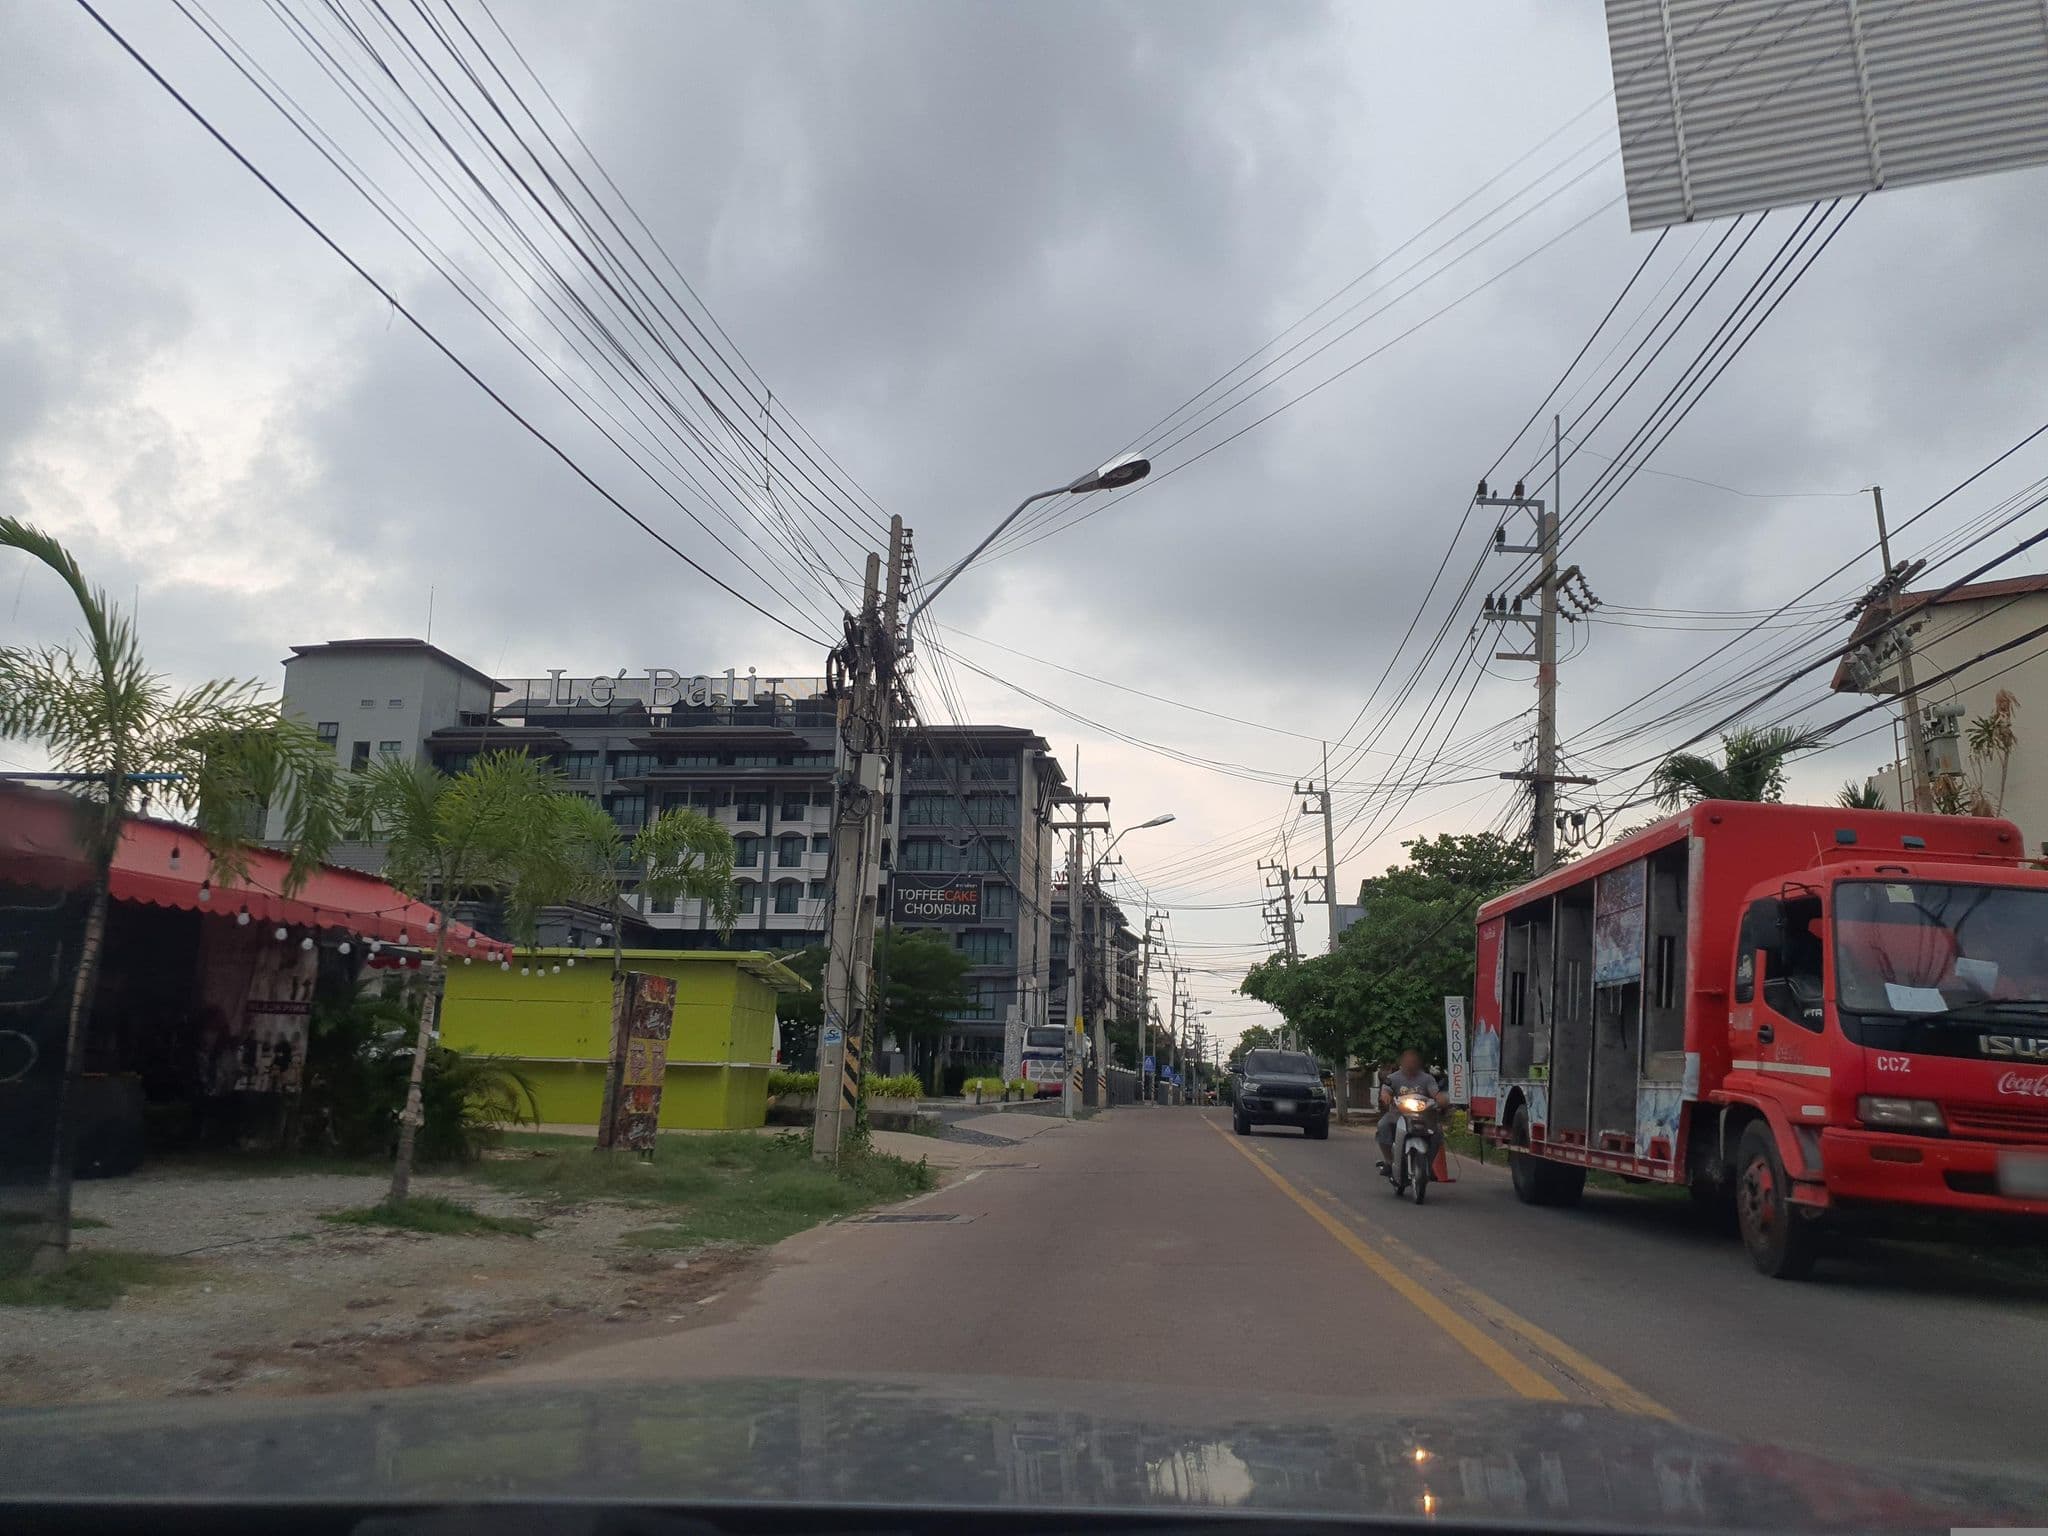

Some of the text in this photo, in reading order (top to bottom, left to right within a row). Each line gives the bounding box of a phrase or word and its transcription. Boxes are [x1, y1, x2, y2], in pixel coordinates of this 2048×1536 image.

[643, 666, 760, 708] Bali
[904, 902, 977, 916] CHONBURI
[1451, 1018, 1463, 1098] AROMDEE
[1877, 1056, 1911, 1073] CCZ
